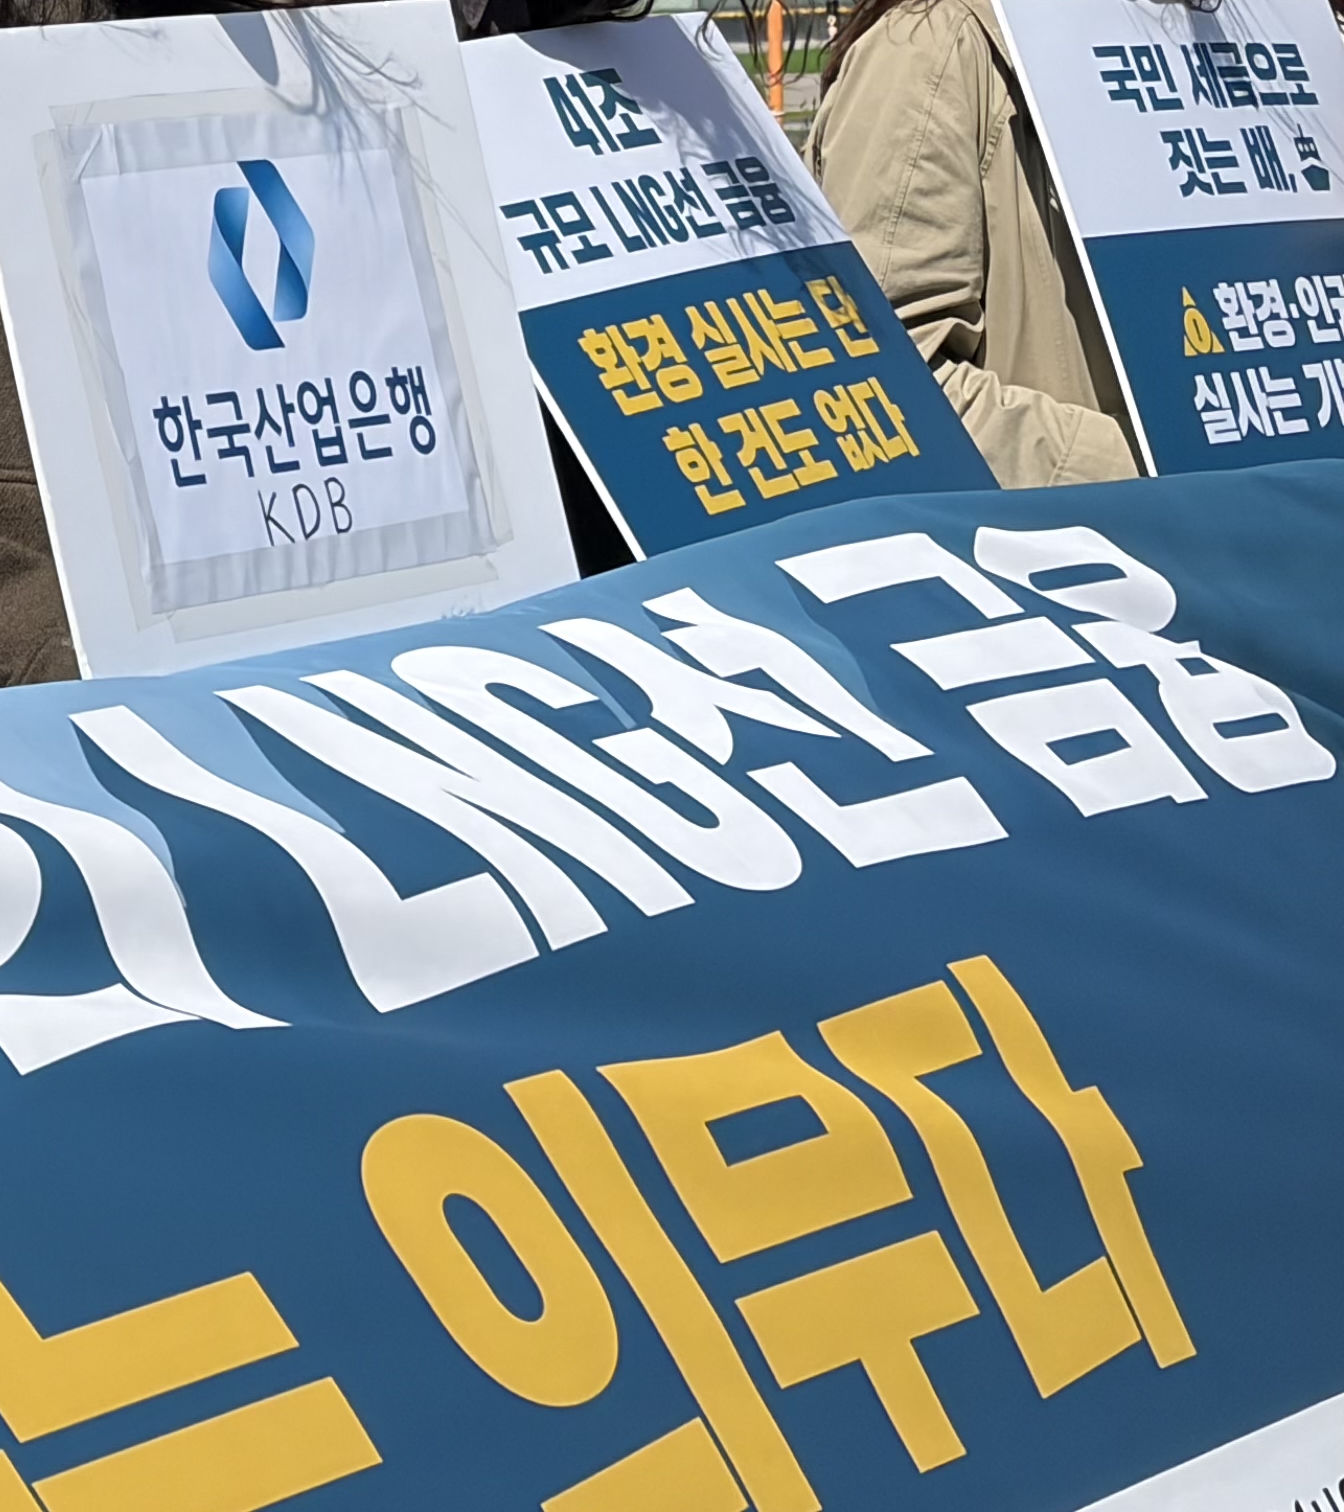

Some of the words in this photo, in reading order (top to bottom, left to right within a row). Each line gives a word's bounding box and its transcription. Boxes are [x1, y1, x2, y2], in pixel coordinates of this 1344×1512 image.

[542, 67, 661, 156] 41조
[1092, 43, 1184, 113] 국민
[1184, 42, 1319, 111] 세금으로
[500, 186, 614, 274] 규모
[589, 167, 727, 253] LNG선
[700, 156, 795, 230] 금융
[1160, 128, 1247, 197] 짓는
[1239, 125, 1298, 193] 배,
[578, 314, 704, 416] 환경
[685, 289, 835, 389] 실사는
[806, 275, 880, 358] 단
[153, 365, 436, 487] 한국산업은행
[662, 423, 746, 515] 한
[718, 398, 839, 500] 건도
[813, 377, 920, 472] 없다
[1194, 366, 1310, 445] 실사는
[256, 477, 353, 546] KDB
[69, 588, 1009, 1015] LNG선
[776, 525, 1338, 820] 금융
[360, 955, 1198, 1512] 의무다
